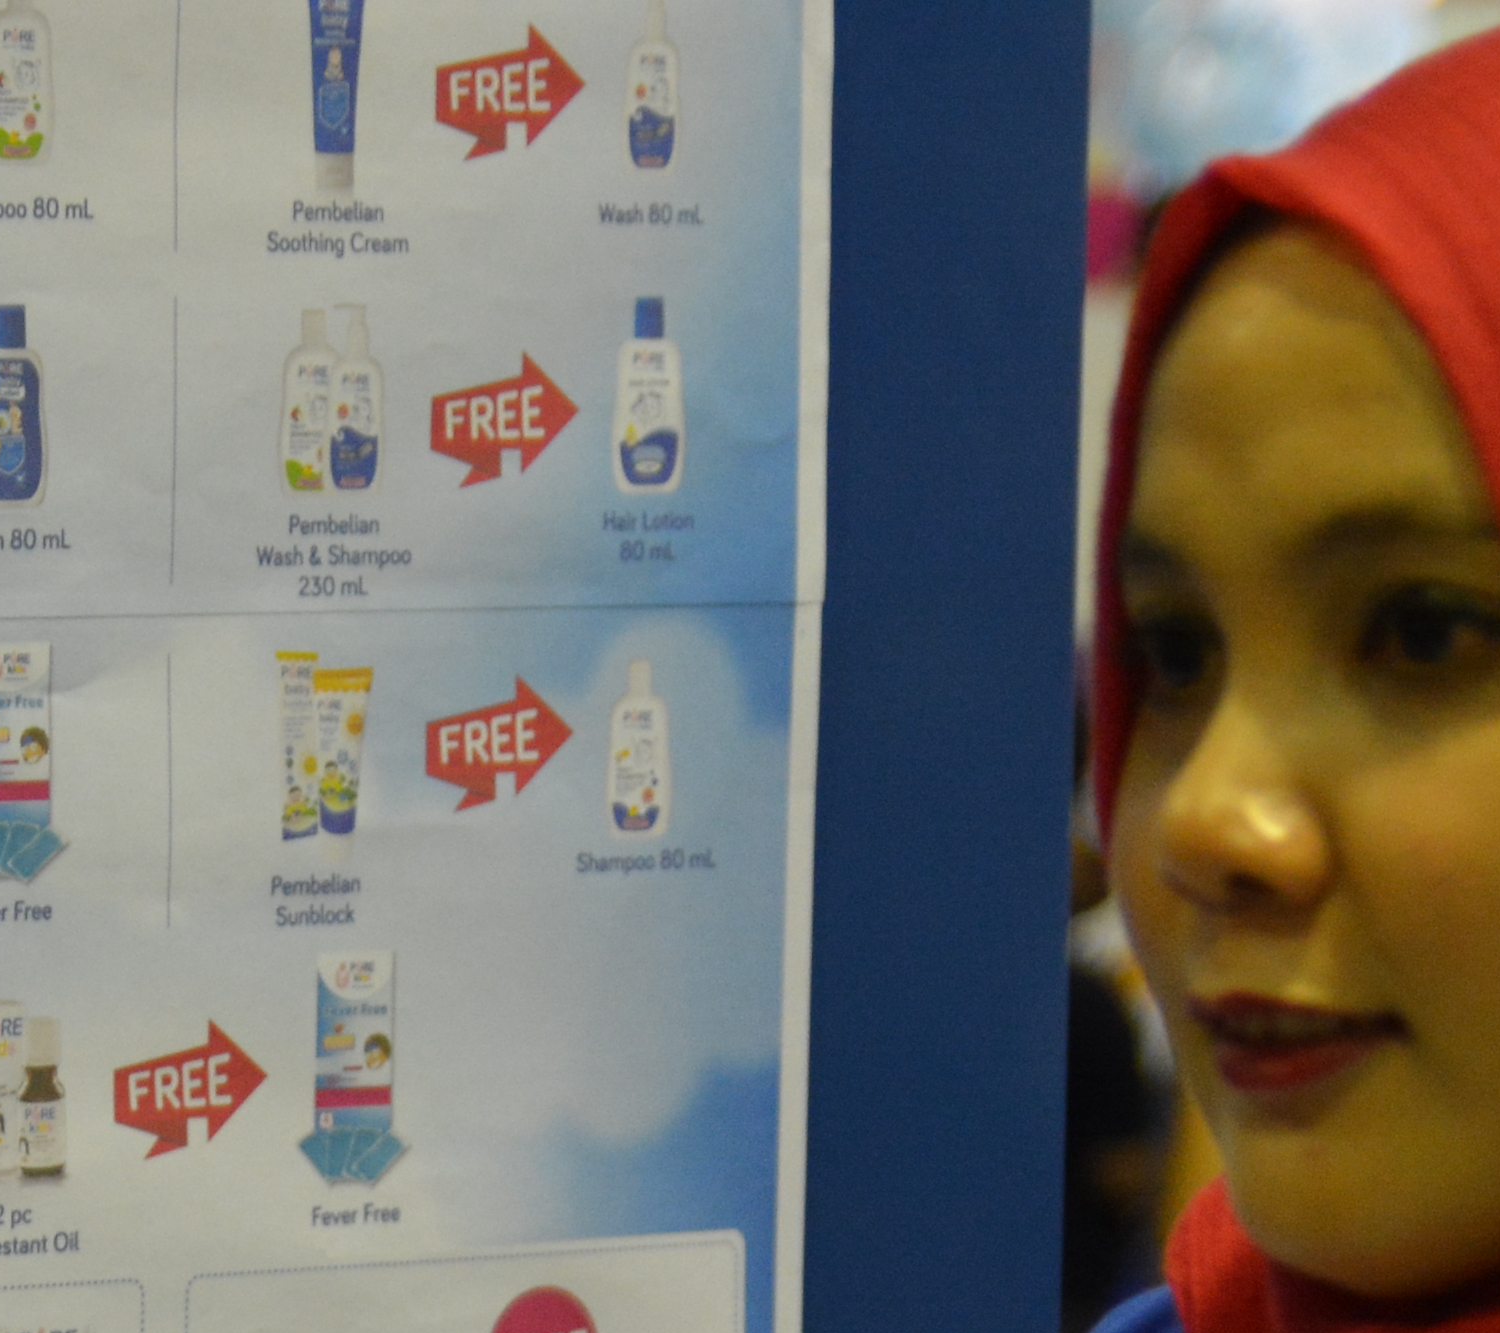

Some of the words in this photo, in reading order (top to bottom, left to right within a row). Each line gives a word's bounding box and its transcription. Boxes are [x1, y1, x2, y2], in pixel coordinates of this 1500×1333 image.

[448, 58, 551, 114] FREE
[33, 198, 58, 219] 80
[62, 197, 95, 219] mL
[292, 201, 384, 225] Pembelian
[600, 203, 643, 226] Wash
[648, 204, 675, 226] 80
[267, 232, 346, 259] Soothing
[350, 232, 410, 255] Cream
[443, 386, 545, 442] FREE
[288, 514, 381, 537] Pembelian
[602, 511, 637, 533] Hair
[10, 529, 35, 551] 80
[39, 528, 71, 551] mL
[619, 540, 647, 562] 80
[256, 545, 304, 568] Wash
[308, 547, 323, 567] &
[328, 544, 412, 571] Shampoo
[298, 575, 336, 598] 230
[339, 575, 368, 598] mL
[438, 708, 540, 767] FREE
[576, 849, 656, 875] Shampoo
[660, 848, 686, 871] 80
[270, 875, 362, 897] Pembelian
[13, 901, 53, 923] Free
[275, 903, 356, 928] Sunblock
[126, 1052, 232, 1112] FREE
[10, 1207, 33, 1230] pc
[311, 1205, 360, 1228] Fever
[364, 1203, 401, 1226] Free
[53, 1231, 80, 1253] Oil
